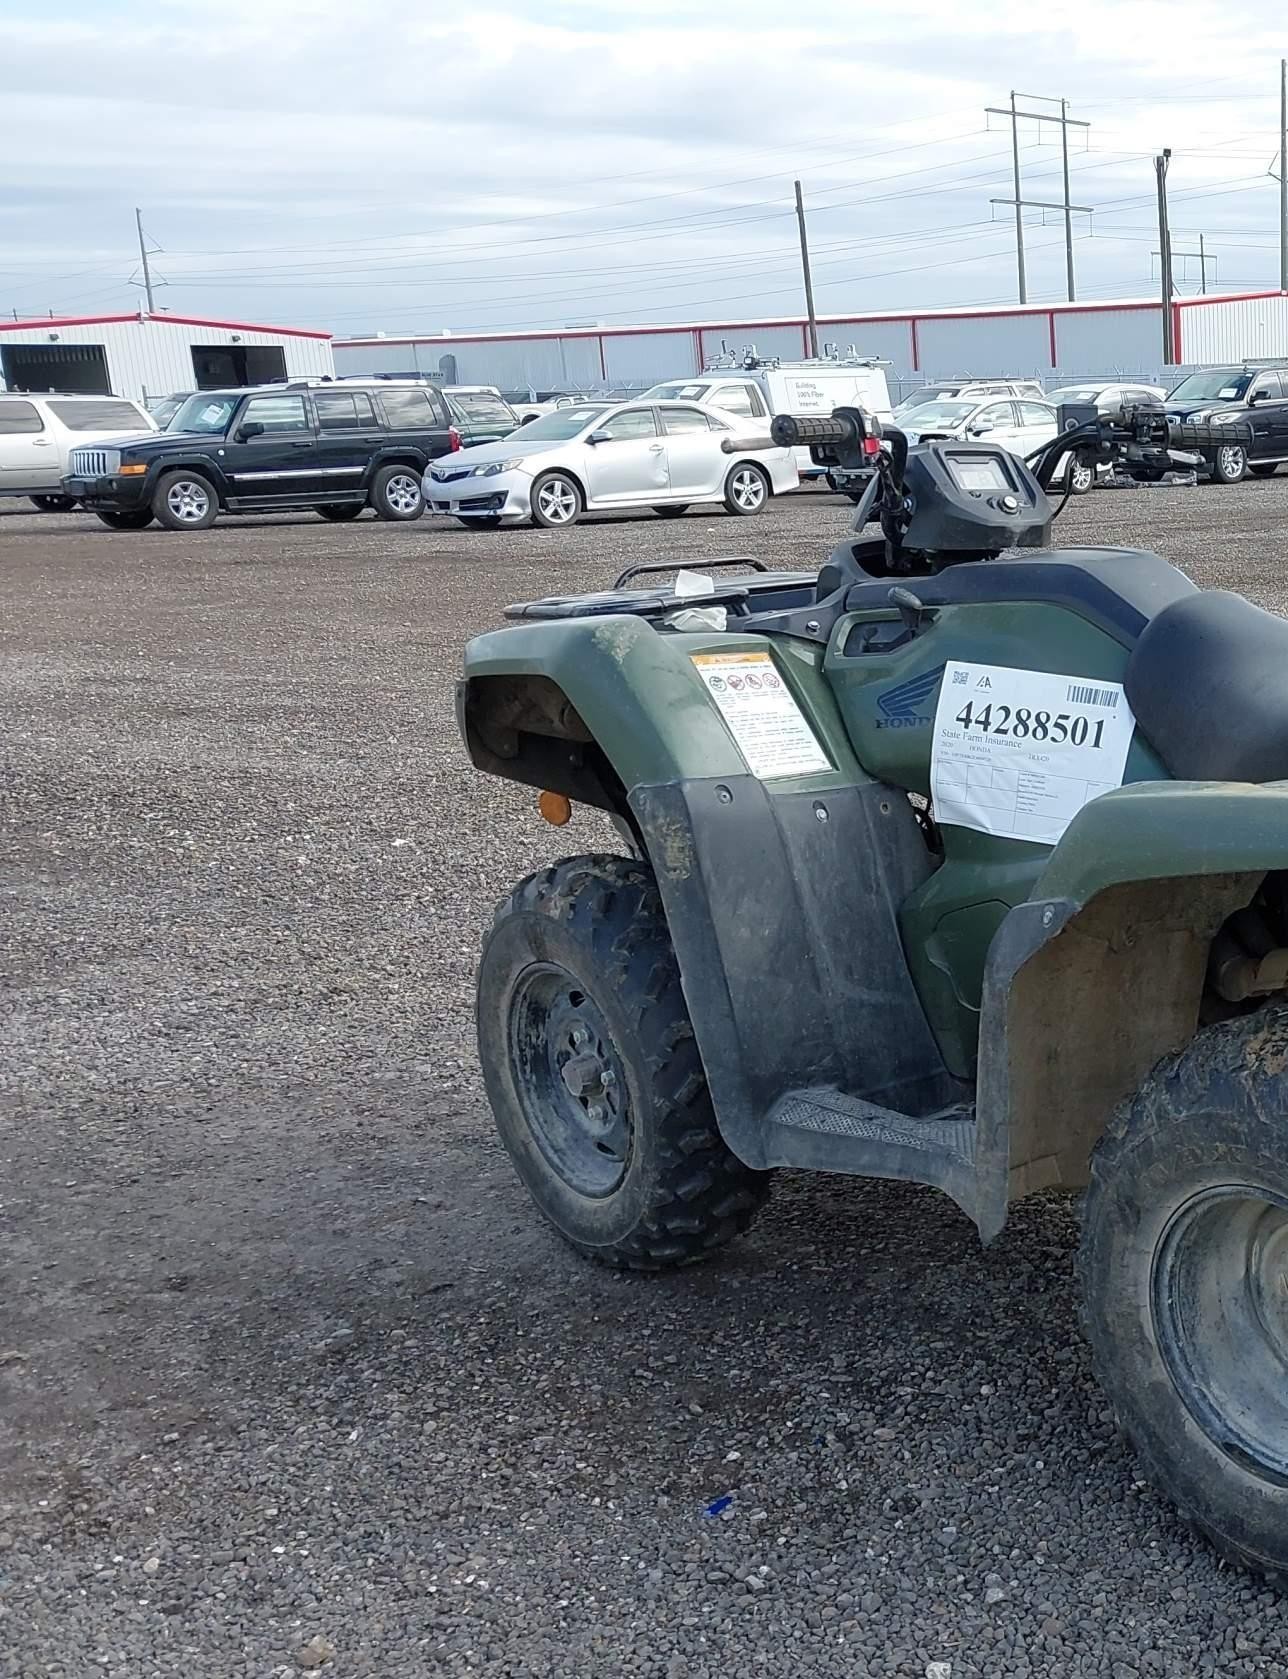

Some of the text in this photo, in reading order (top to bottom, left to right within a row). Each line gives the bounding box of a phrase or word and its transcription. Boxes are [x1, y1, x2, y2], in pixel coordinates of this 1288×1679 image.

[875, 716, 936, 729] HOND
[955, 700, 1106, 750] 44288501
[941, 729, 1022, 748] State Farm Insurance
